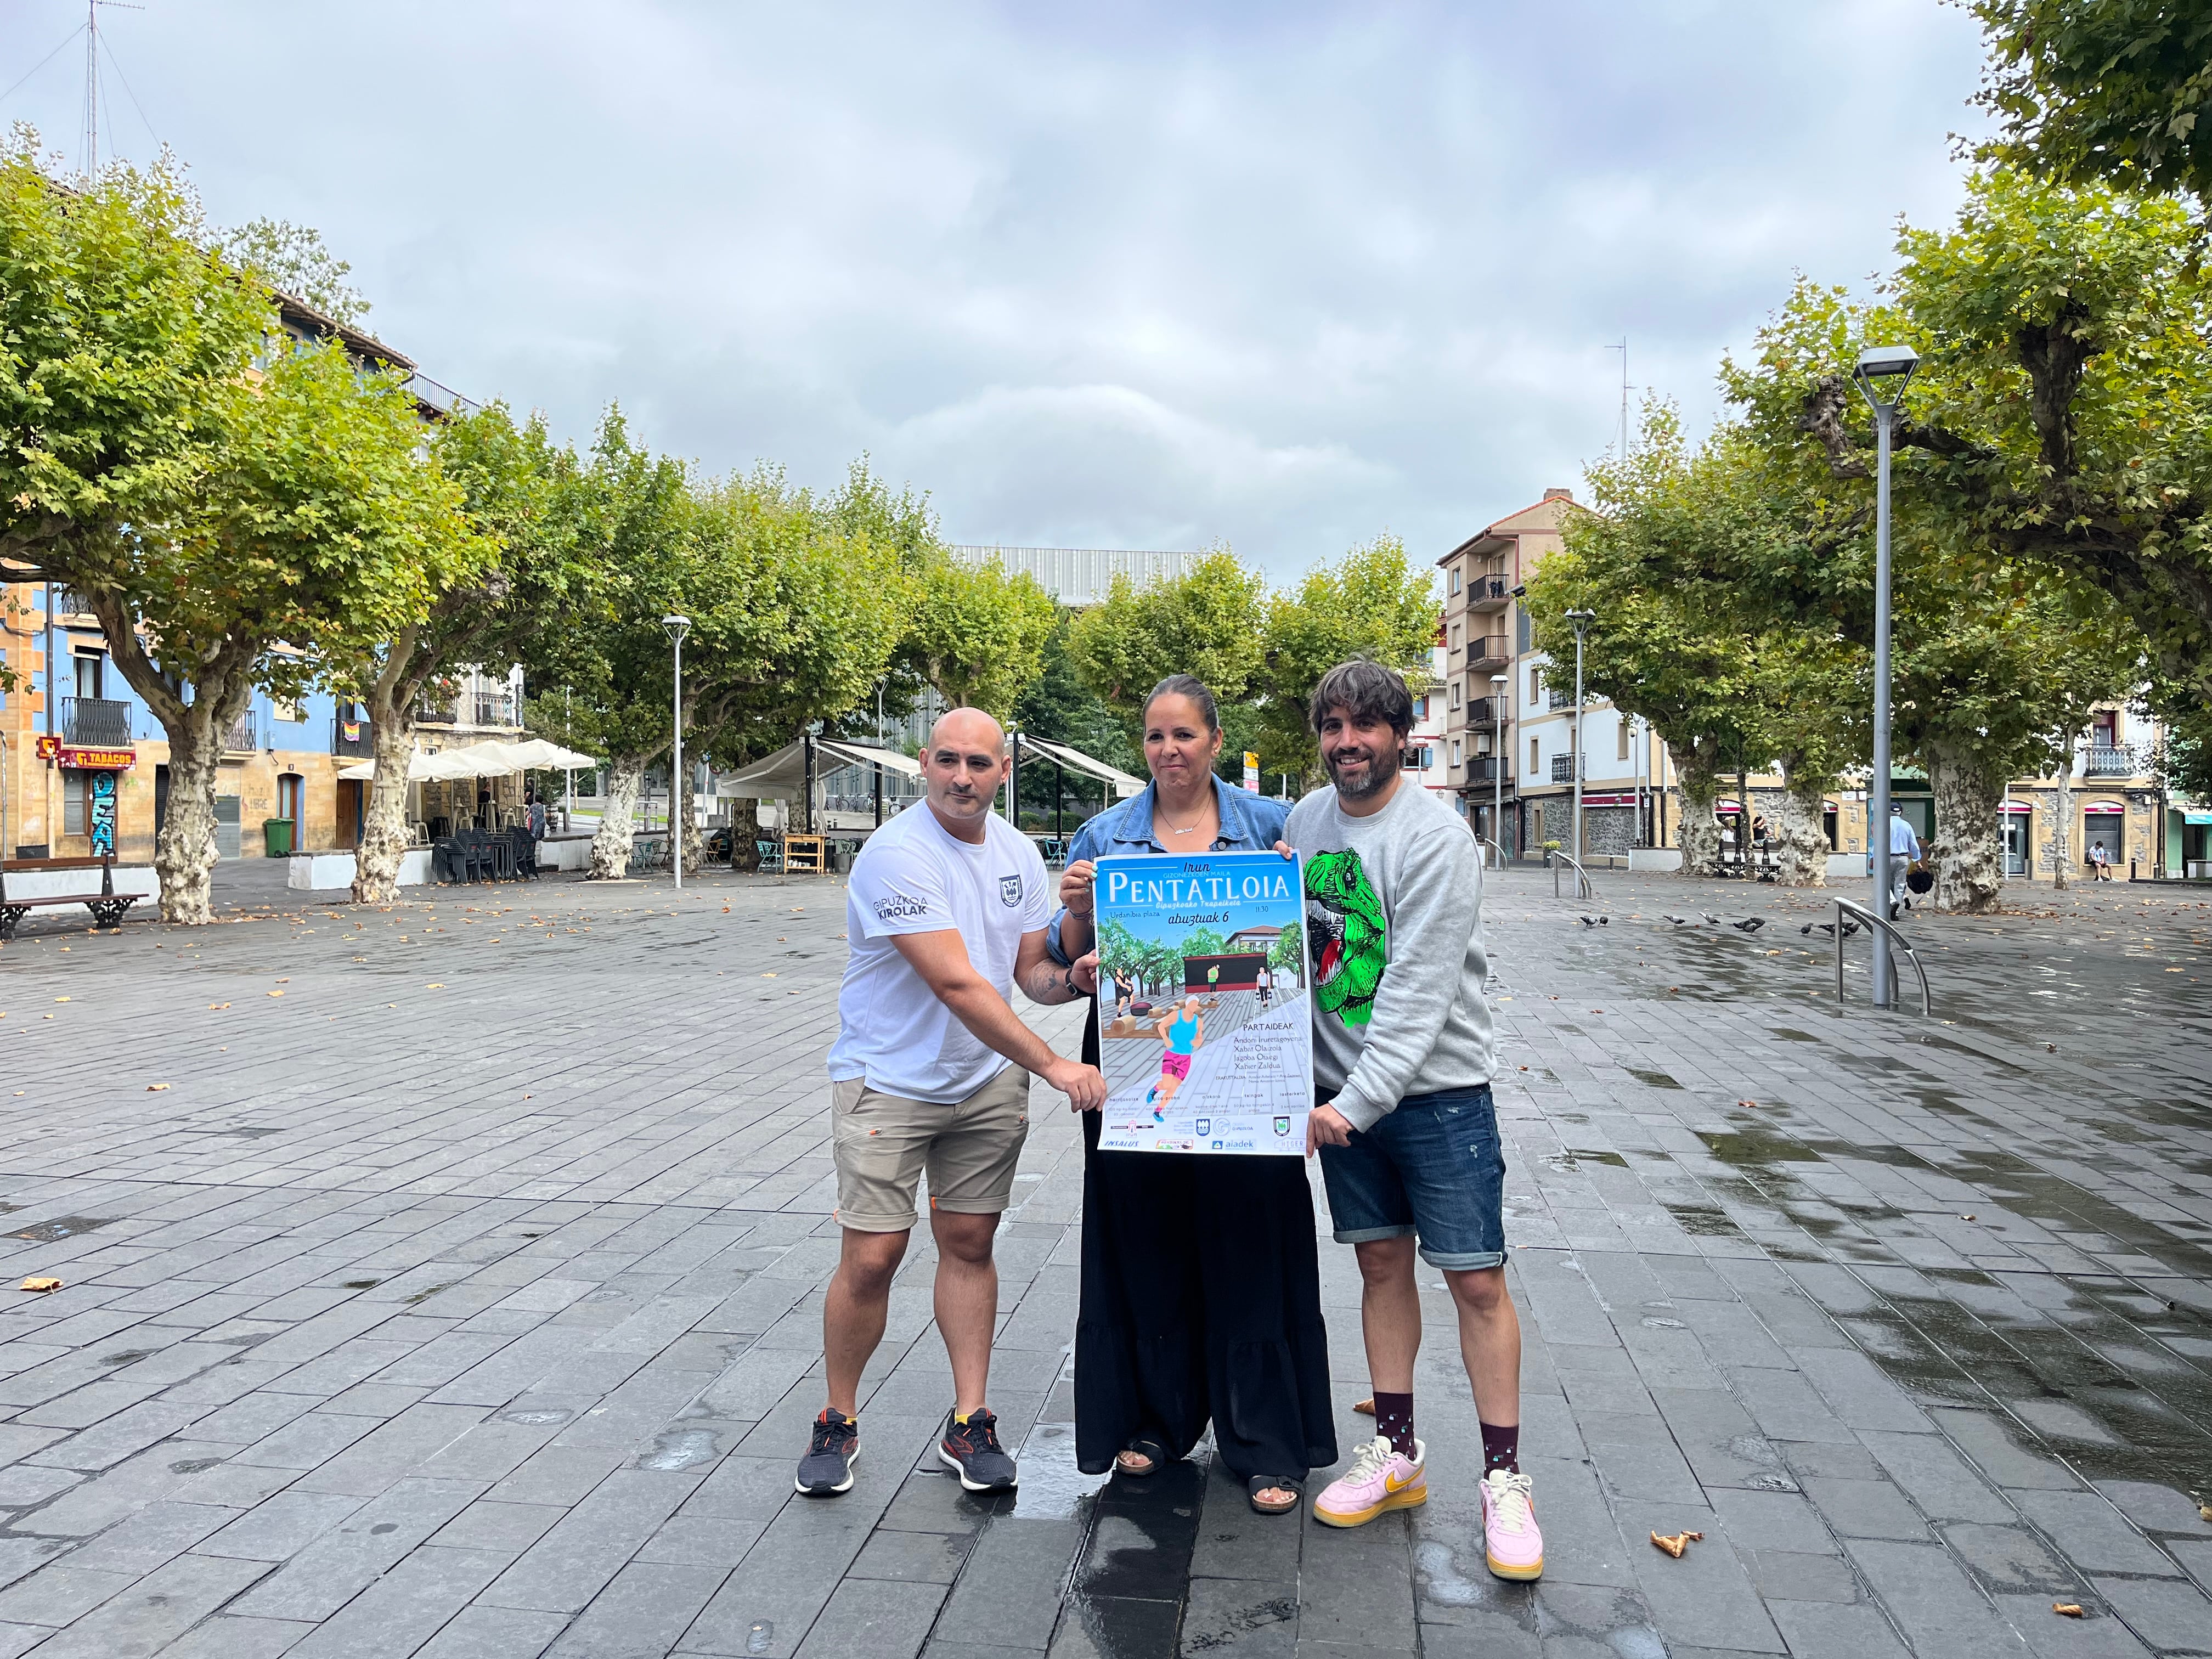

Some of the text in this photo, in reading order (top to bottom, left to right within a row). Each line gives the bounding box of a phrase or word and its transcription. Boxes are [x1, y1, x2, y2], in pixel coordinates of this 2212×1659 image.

[89, 752, 131, 764] TABACOS
[1183, 862, 1210, 872] Irun
[1109, 872, 1289, 903] PENTATLOIA
[873, 896, 928, 911] GIPUZKOA
[1156, 901, 1197, 910] Gipuzkoako
[877, 905, 928, 921] KIROLAK
[1110, 910, 1142, 919] Urdanibia
[1169, 911, 1229, 926] abuztuak 6
[1243, 1023, 1294, 1031] PARTAIDEAK
[1259, 1035, 1302, 1043] Iruretagoyena
[1234, 1053, 1278, 1062] Jagoba Otaegi
[1226, 1139, 1254, 1148] aiadek
